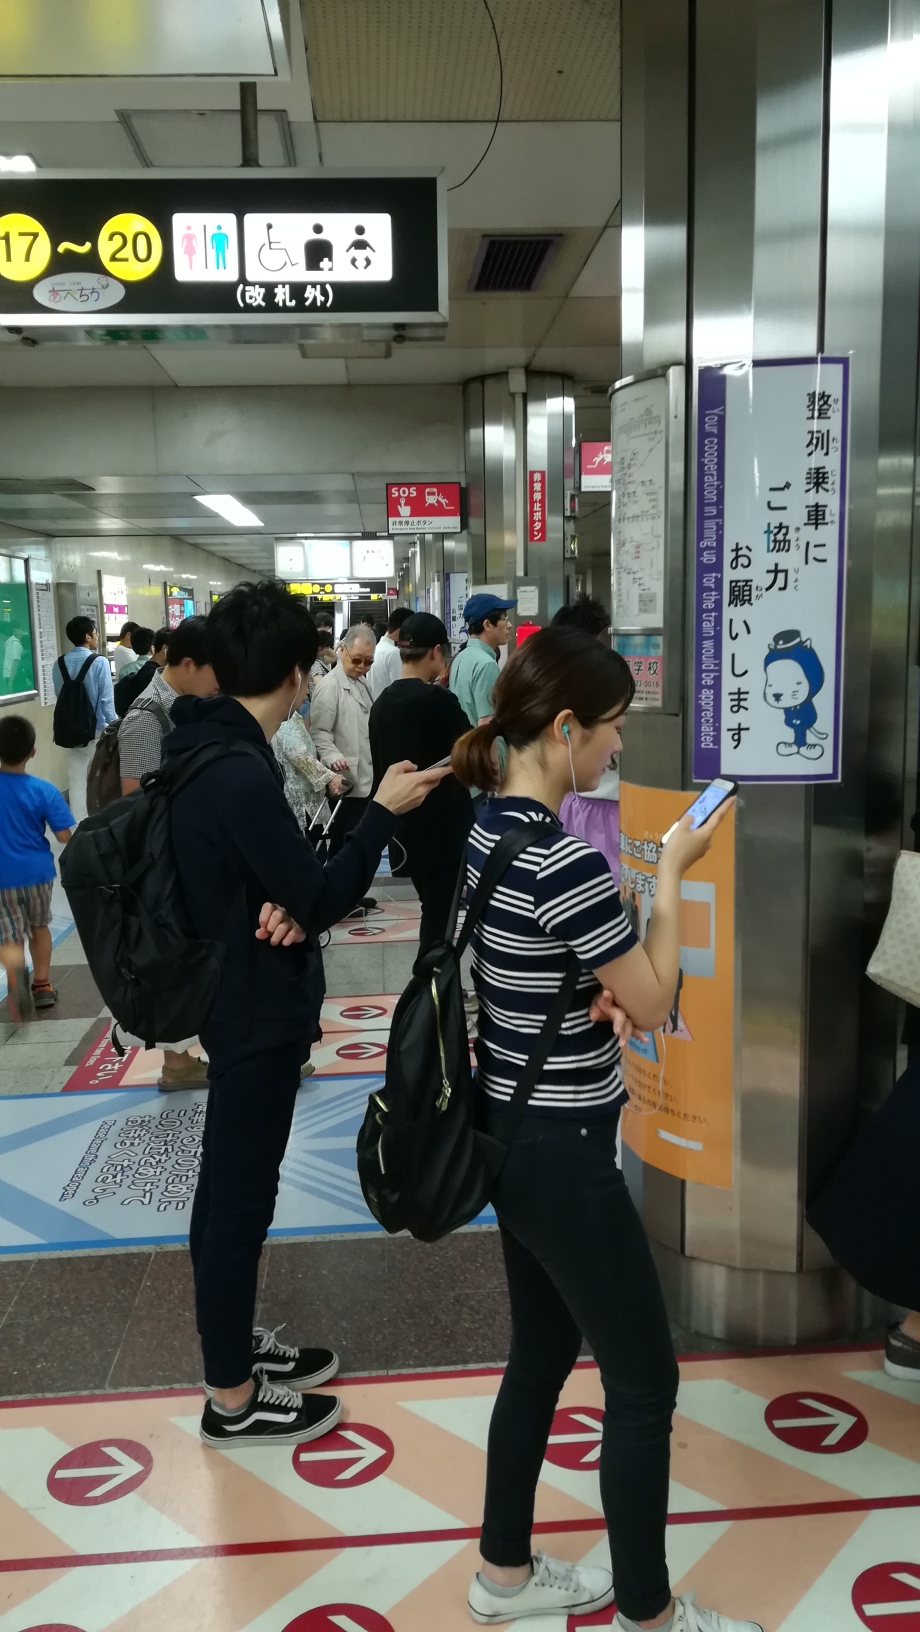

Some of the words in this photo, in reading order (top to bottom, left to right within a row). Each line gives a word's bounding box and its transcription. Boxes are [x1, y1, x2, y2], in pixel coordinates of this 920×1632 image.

[107, 230, 152, 263] 20
[704, 406, 725, 435] Your
[700, 437, 724, 503] cooperation
[803, 390, 832, 566] 整列乗車に
[391, 487, 417, 498] SOS
[532, 471, 542, 541] 非常停止ボタン
[391, 519, 433, 527] 非常停止ボタン
[703, 505, 723, 516] in
[700, 518, 723, 548] lining
[764, 481, 792, 593] ご協力
[700, 549, 717, 565] up
[702, 572, 721, 586] for
[702, 589, 720, 610] the
[701, 612, 720, 638] train
[701, 639, 720, 670] would
[727, 541, 754, 750] お願いします
[701, 672, 720, 687] be
[698, 688, 719, 750] appreciated
[94, 1119, 117, 1139] Please
[83, 1114, 155, 1206] お待ちください。
[85, 1137, 108, 1154] leave
[120, 1109, 187, 1206] この付近をあけて
[69, 1166, 89, 1182] area
